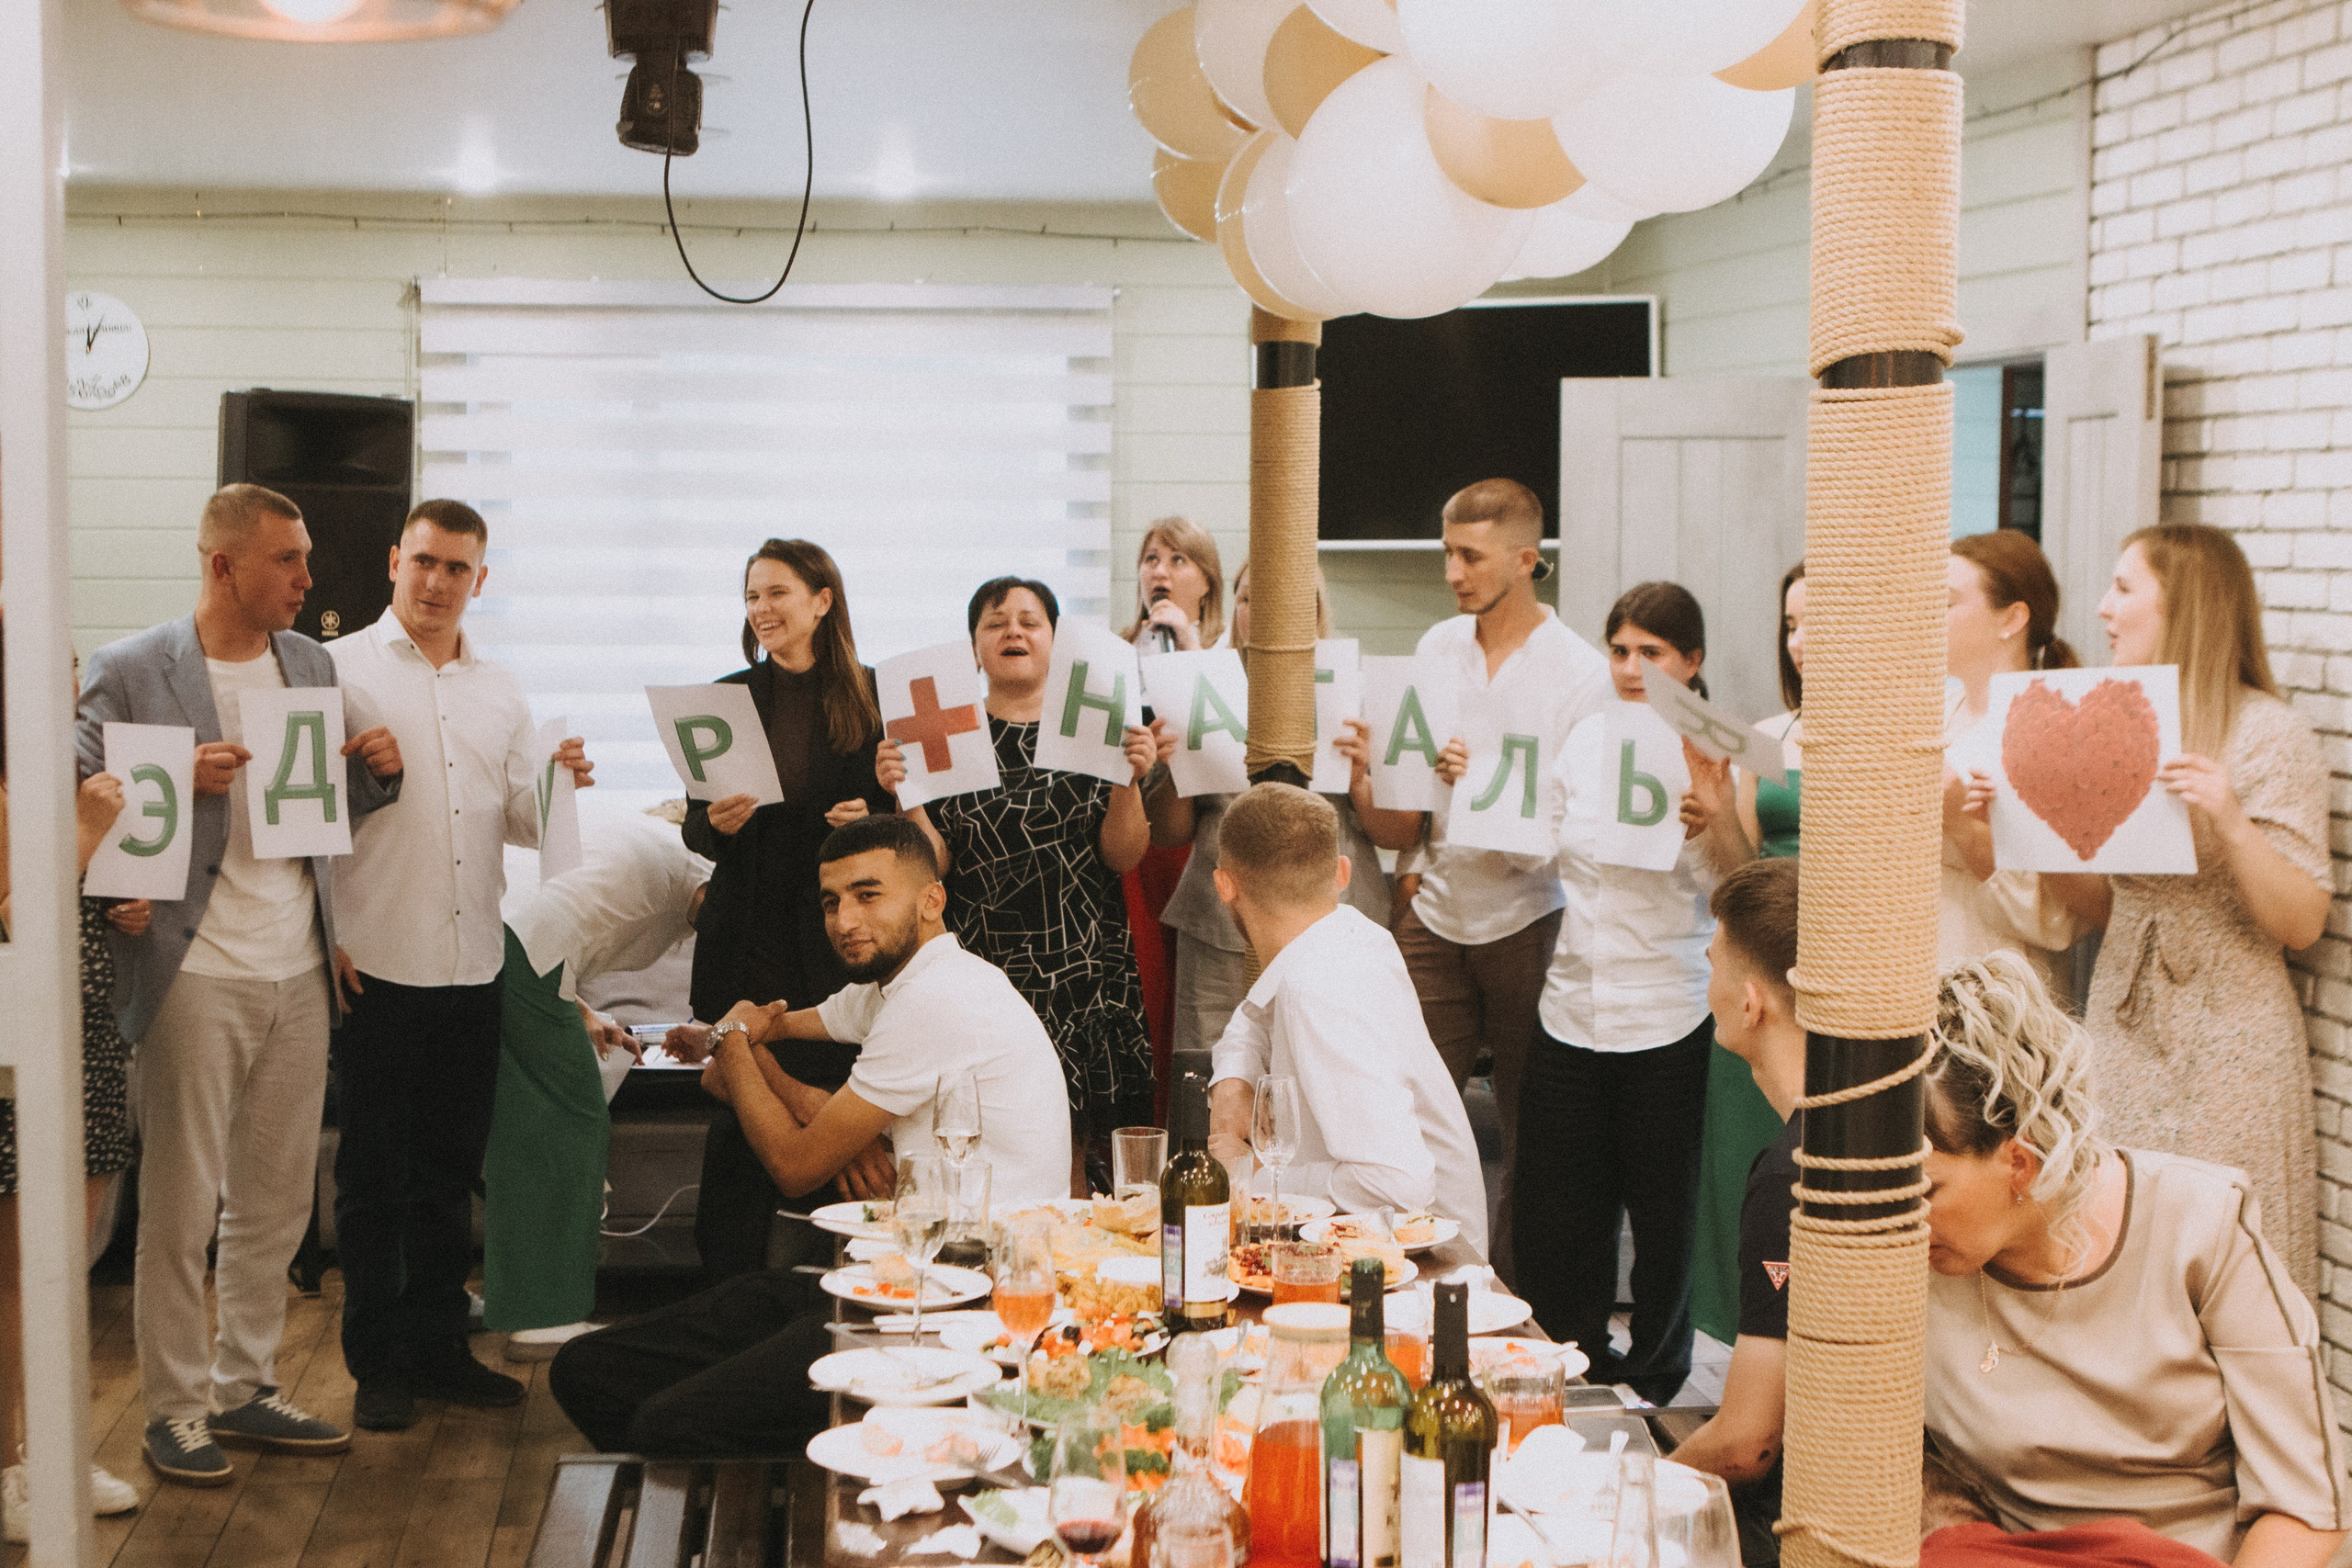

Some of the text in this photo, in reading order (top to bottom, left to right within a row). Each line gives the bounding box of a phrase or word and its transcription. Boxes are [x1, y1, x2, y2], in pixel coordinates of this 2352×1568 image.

[264, 710, 336, 825] Д
[1383, 684, 1439, 768] А
[119, 763, 178, 857] Э
[1470, 733, 1539, 818] Л
[1617, 739, 1668, 827] Ь
